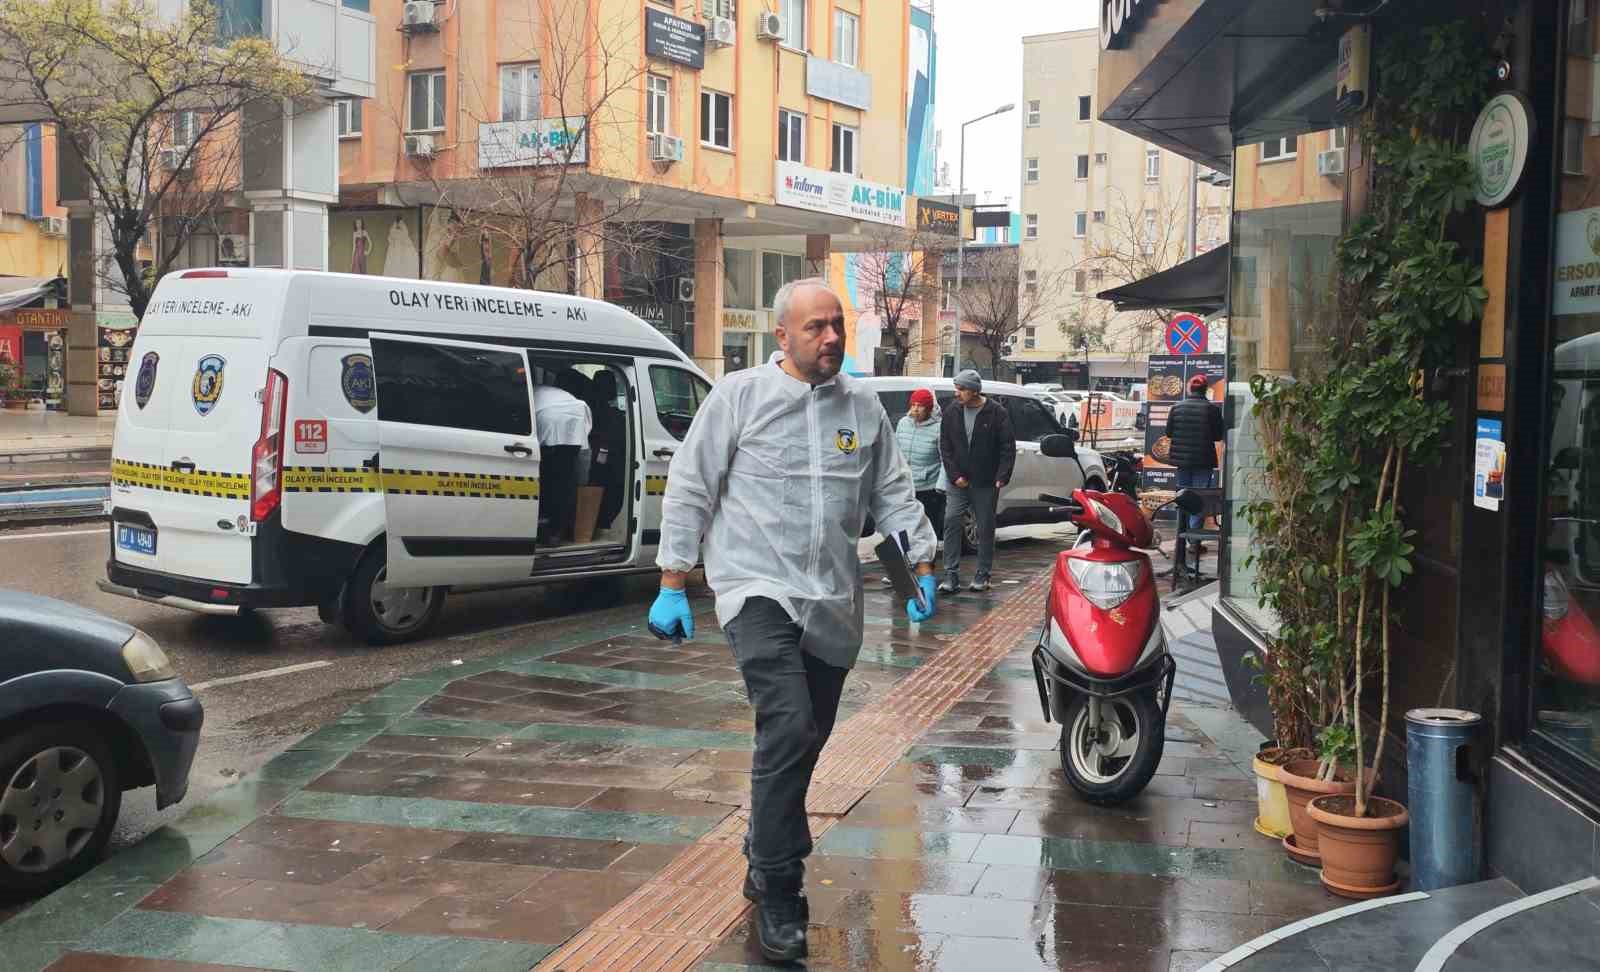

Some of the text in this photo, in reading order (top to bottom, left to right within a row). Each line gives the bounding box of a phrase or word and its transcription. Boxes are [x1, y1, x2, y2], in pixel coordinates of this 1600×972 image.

[793, 175, 823, 195] inform
[389, 289, 431, 308] OLAY
[299, 423, 322, 440] 112
